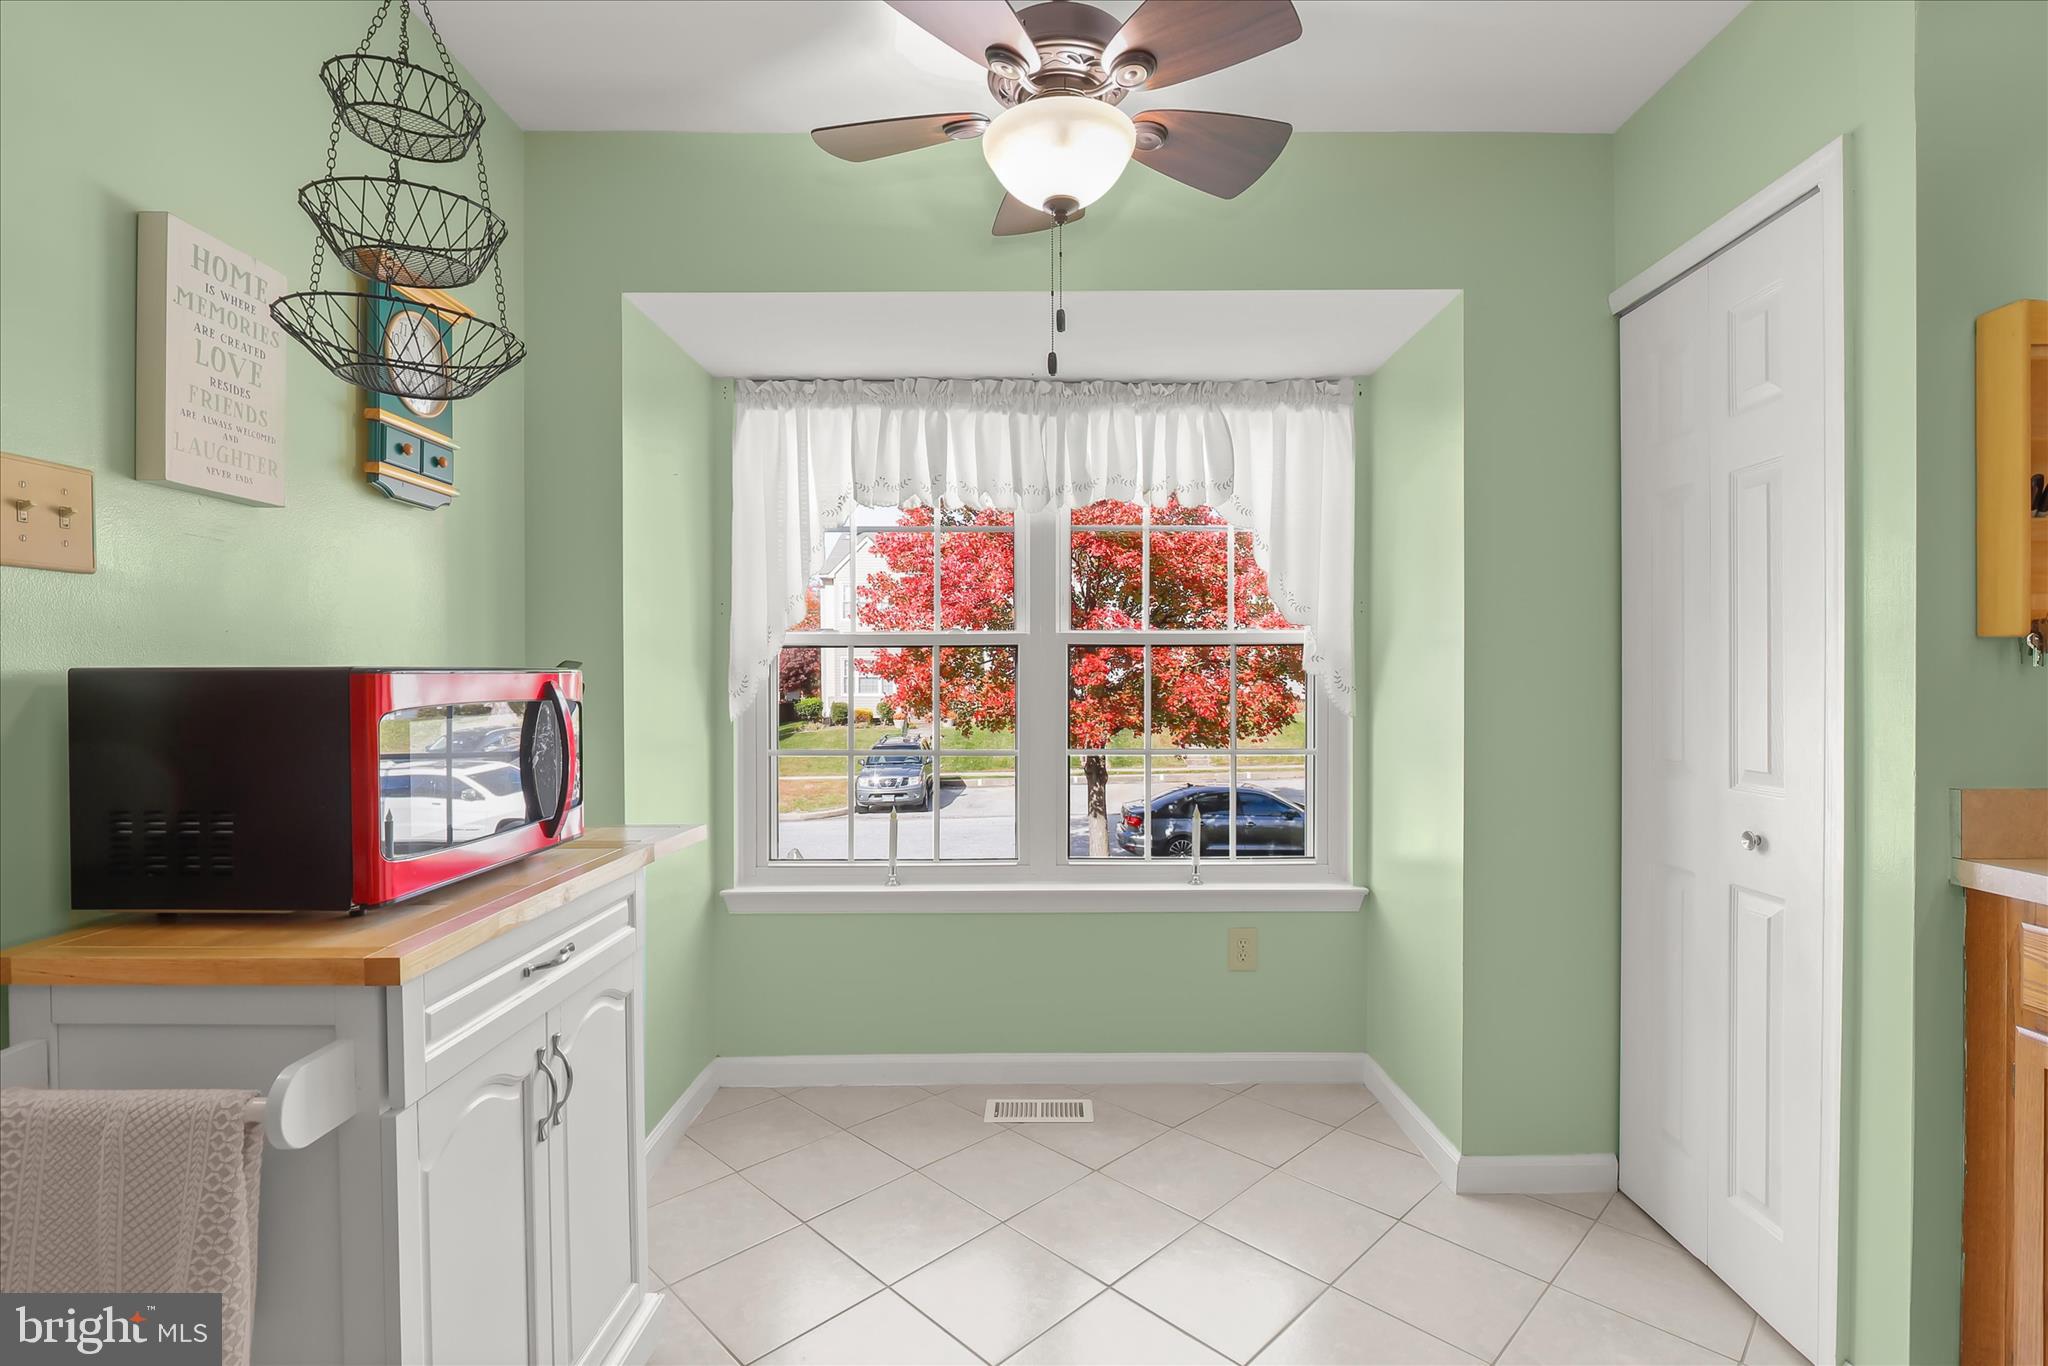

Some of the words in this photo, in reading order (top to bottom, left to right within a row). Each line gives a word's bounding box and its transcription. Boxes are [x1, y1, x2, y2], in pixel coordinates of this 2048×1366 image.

[191, 243, 268, 304] HOME
[174, 284, 280, 349] MEMORIES
[205, 283, 215, 296] IS
[220, 290, 256, 315] WHERE
[193, 322, 215, 339] ARE
[220, 333, 266, 360] CREATED
[195, 338, 263, 388] LOVE
[188, 384, 268, 428] FRIENDS
[209, 376, 251, 400] RESIDES
[180, 408, 196, 420] ARE
[202, 415, 233, 431] ALWAYS
[236, 425, 276, 445] WELCOMED
[223, 433, 239, 444] AND
[174, 431, 279, 479] LAUGHTER
[206, 466, 232, 480] NEVER
[235, 473, 254, 485] ENDS
